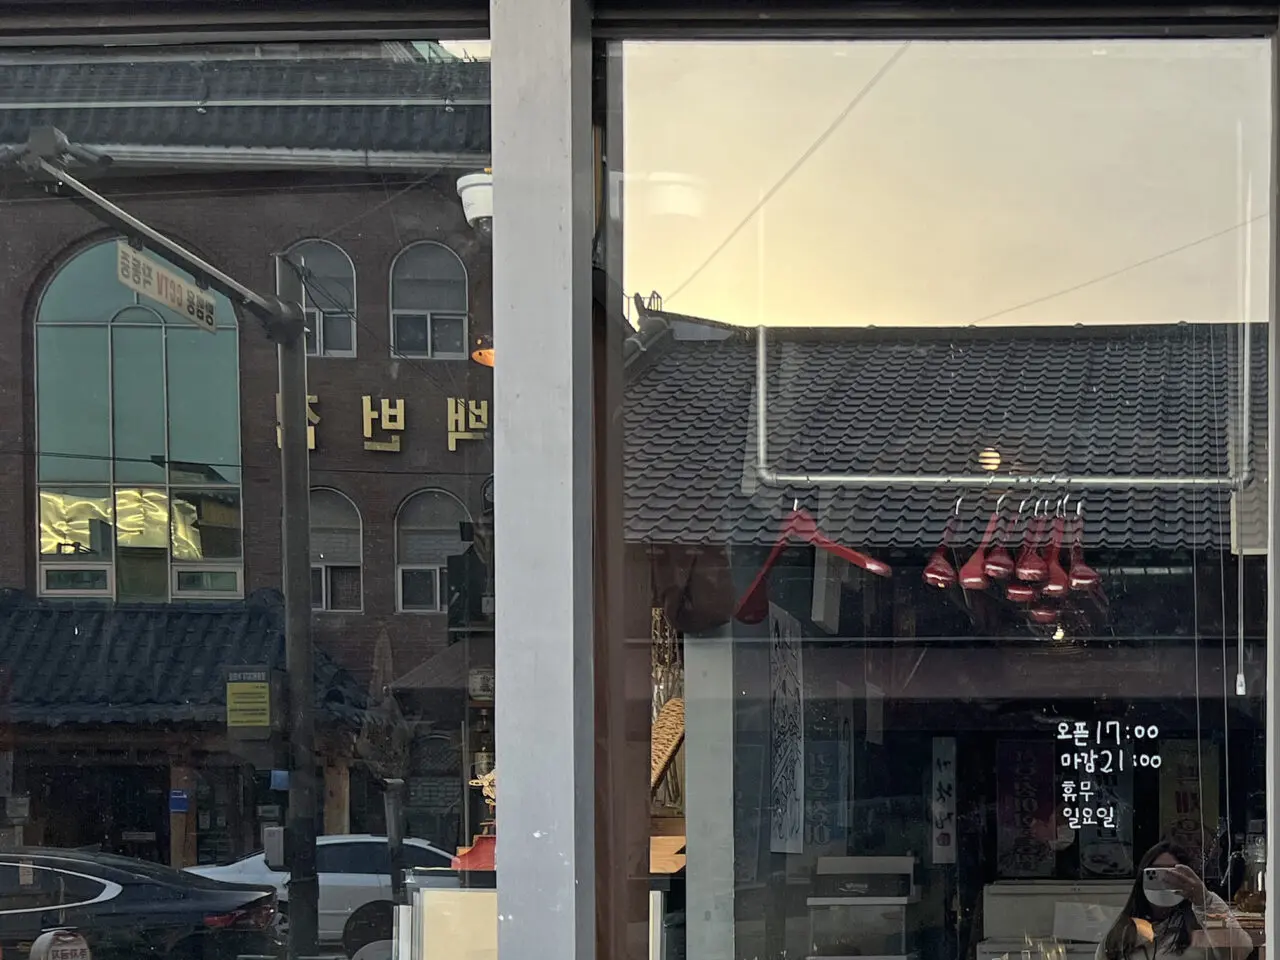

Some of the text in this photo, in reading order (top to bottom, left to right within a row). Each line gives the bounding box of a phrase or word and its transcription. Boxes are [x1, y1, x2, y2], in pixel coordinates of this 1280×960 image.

[1057, 720, 1159, 746] 오픈 17:00
[1099, 749, 1162, 774] 21:00
[1062, 780, 1095, 803] 휴무
[1062, 806, 1116, 829] 일요일
